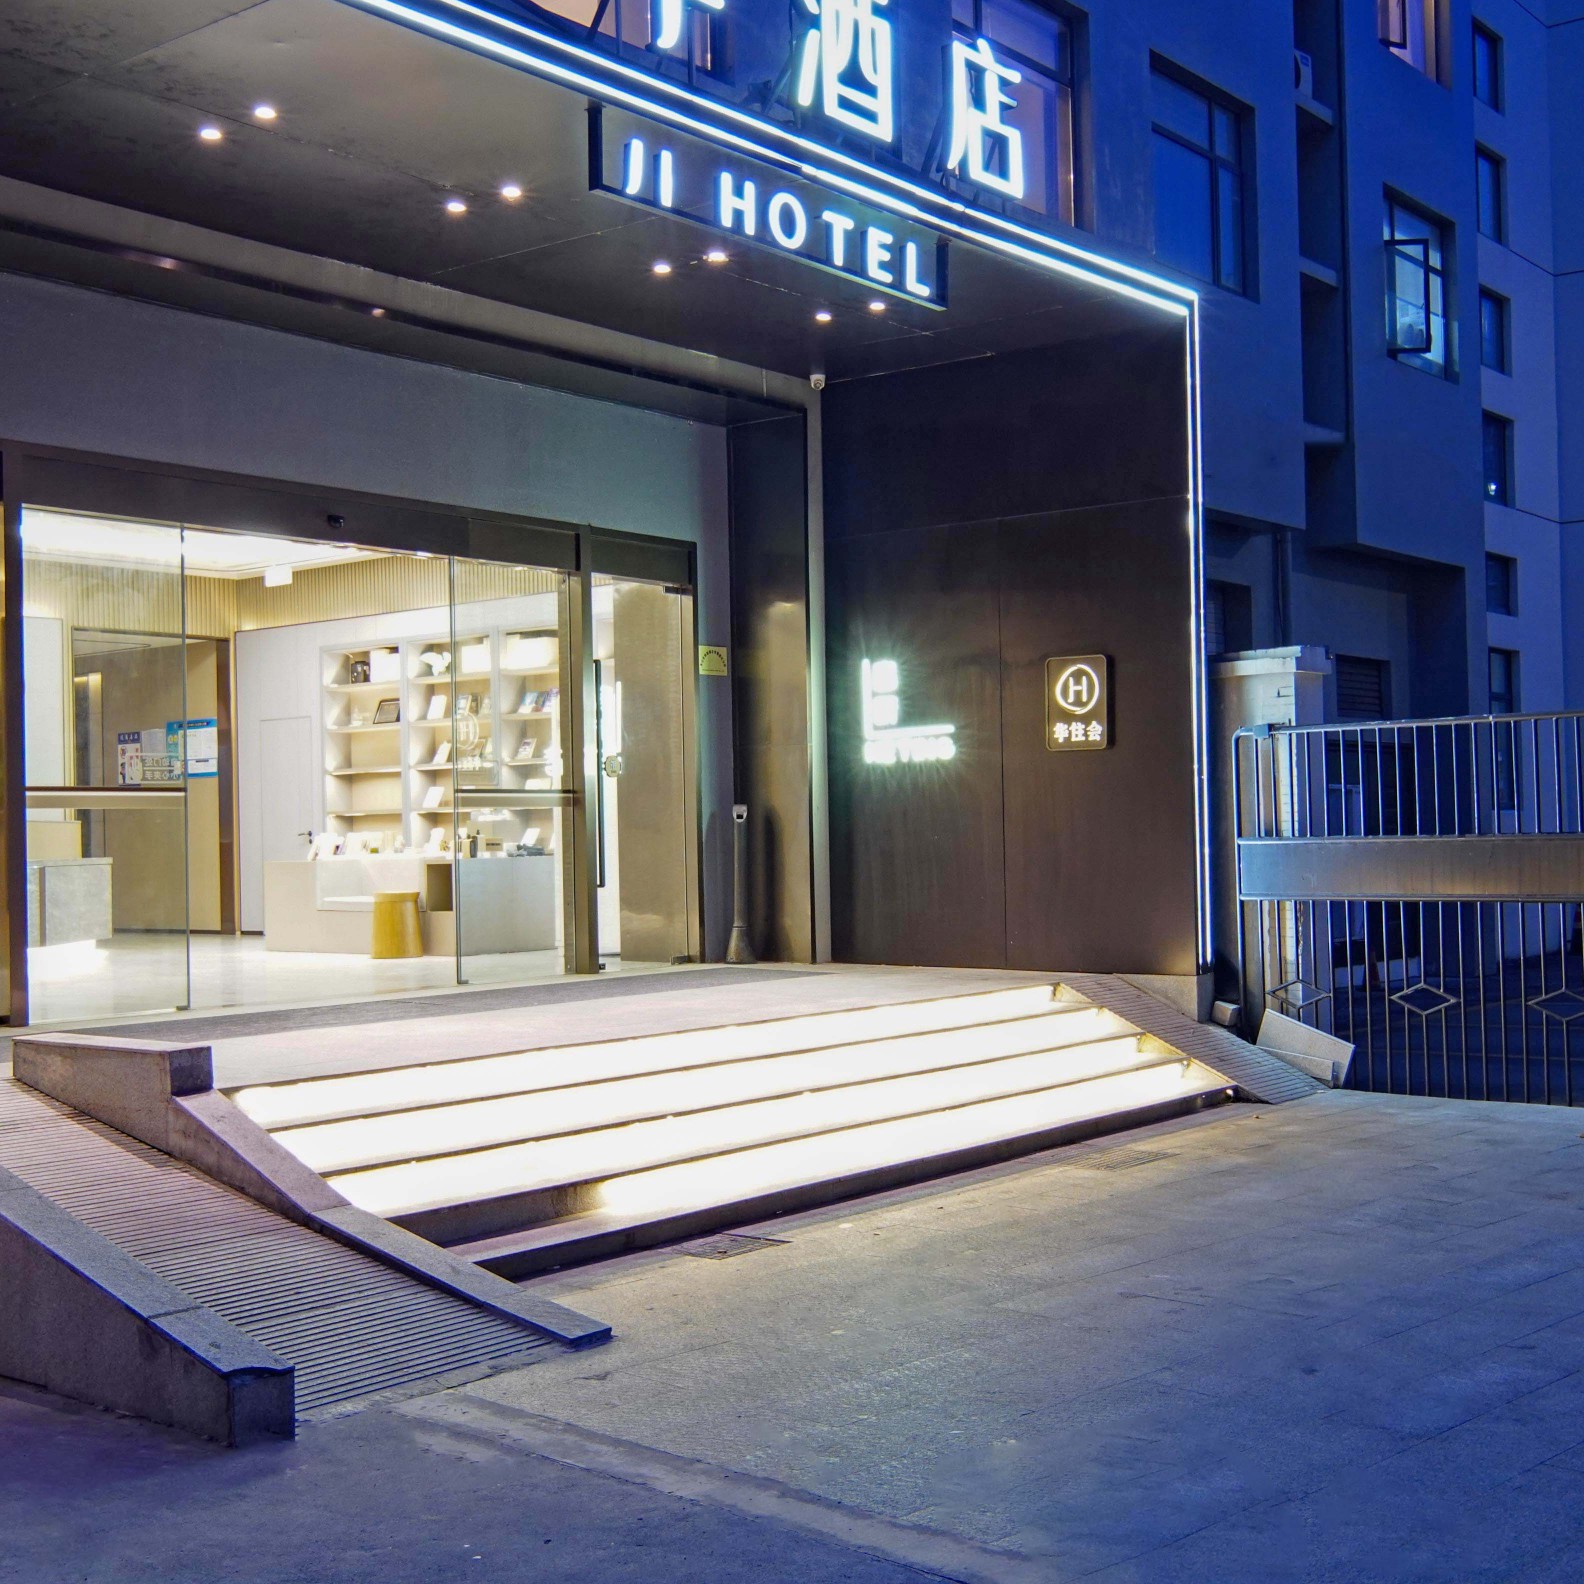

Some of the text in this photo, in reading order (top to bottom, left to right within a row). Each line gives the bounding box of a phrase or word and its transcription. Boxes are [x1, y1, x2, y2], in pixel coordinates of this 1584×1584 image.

[623, 137, 932, 298] JI HOTEL
[1053, 720, 1103, 743] 华住会
